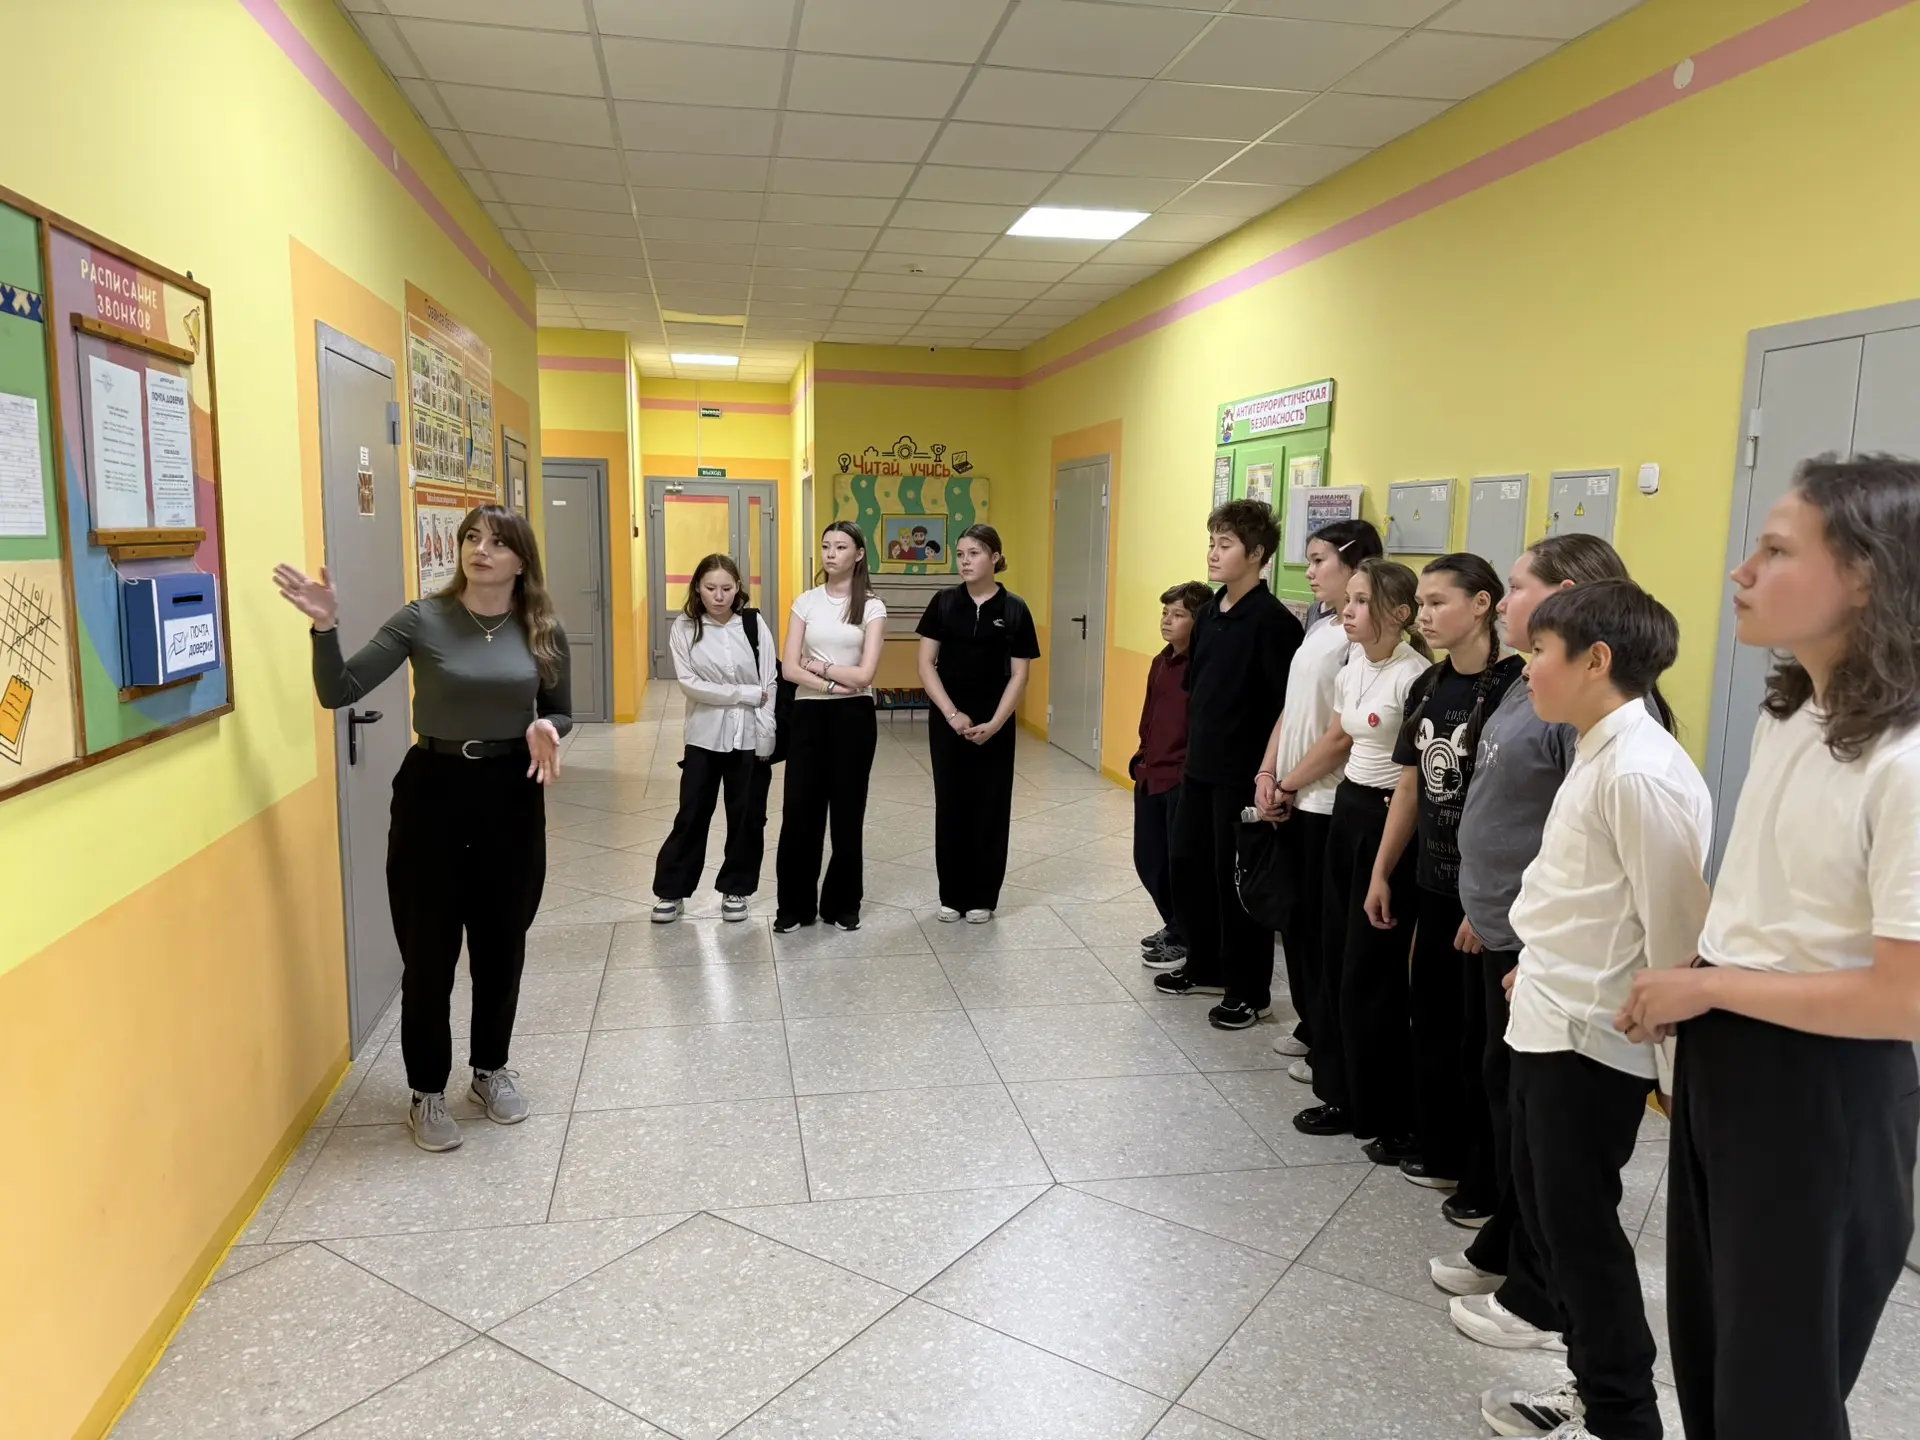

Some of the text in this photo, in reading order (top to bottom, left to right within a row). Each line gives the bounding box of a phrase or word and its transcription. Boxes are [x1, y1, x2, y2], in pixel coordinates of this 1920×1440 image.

[80, 258, 158, 309] РАСПИСАНИЕ
[96, 294, 152, 332] ЗВОНКОВ
[151, 391, 165, 403] ПОЧТА
[1235, 386, 1327, 419] АНТИТЕРРОРИСТИЧЕСКАЯ
[1251, 408, 1305, 430] БЕЗОПАСНОСТЬ
[190, 623, 210, 639] ПОЧТА
